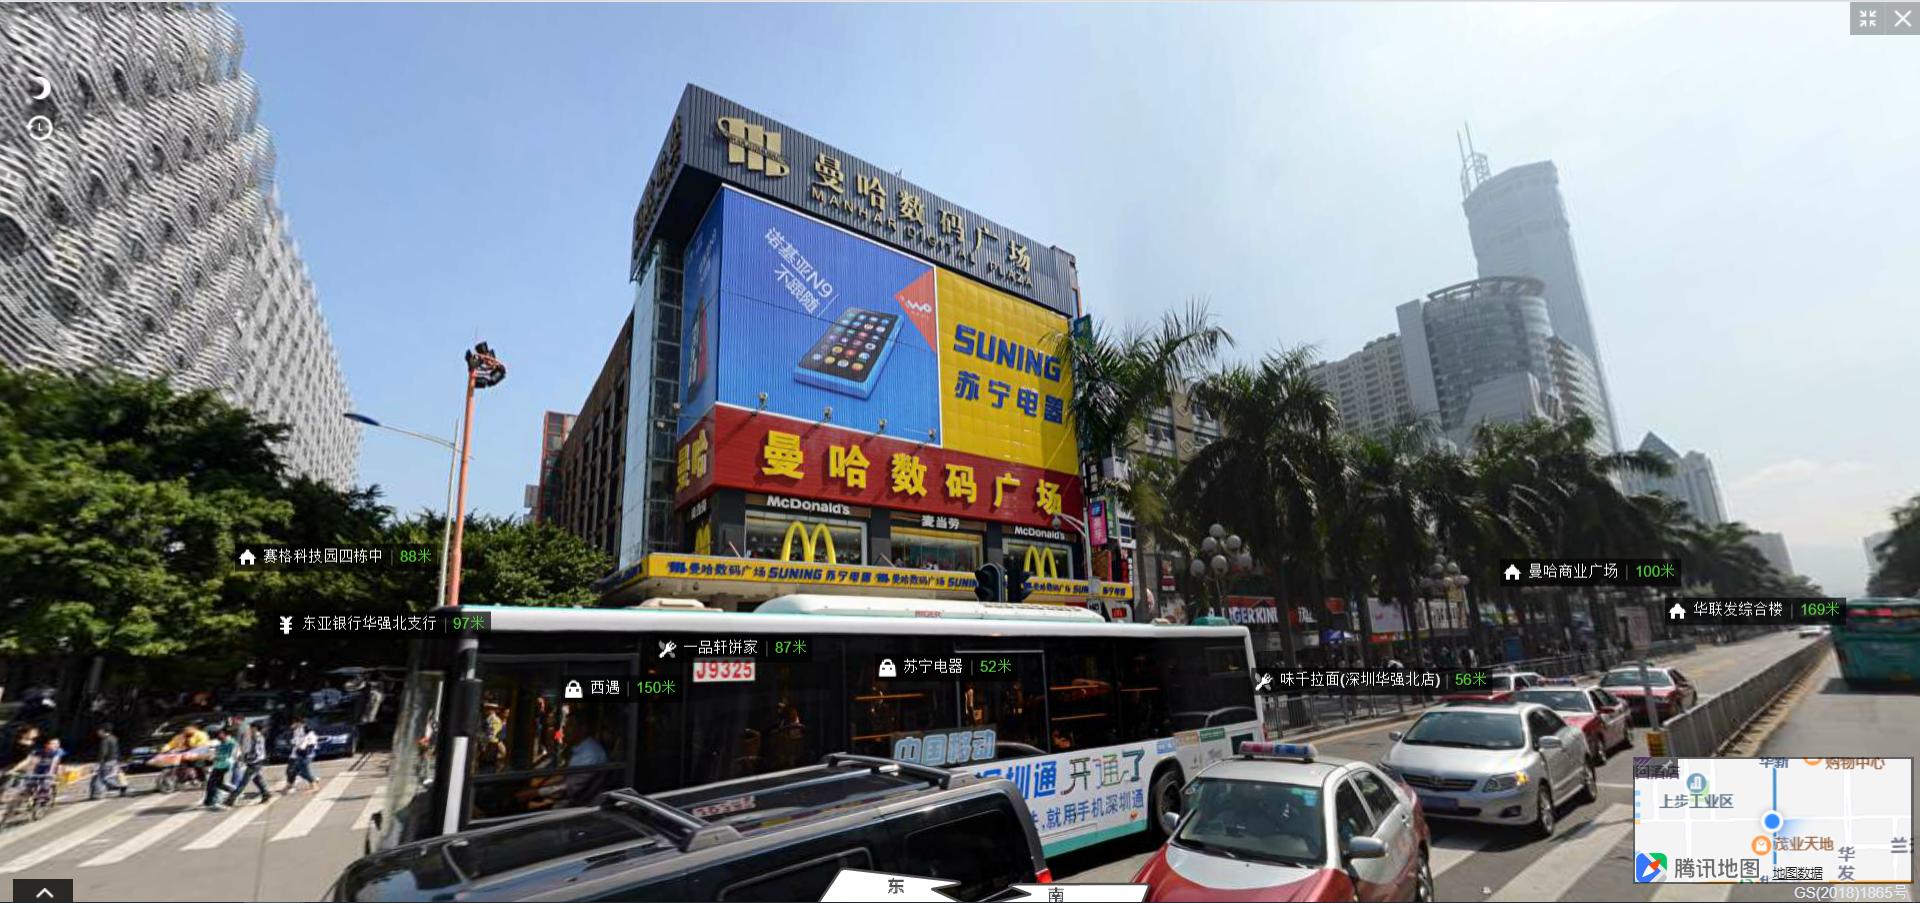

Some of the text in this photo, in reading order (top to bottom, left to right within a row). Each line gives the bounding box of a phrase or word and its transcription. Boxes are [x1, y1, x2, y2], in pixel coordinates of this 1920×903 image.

[811, 186, 1033, 288] MANHAR DIGITAL PLAZA
[814, 152, 1032, 273] 曼哈数码广场
[765, 226, 833, 298] 诺基亚N9
[774, 263, 820, 315] 不跟随
[954, 323, 1062, 383] SUNING
[955, 370, 1064, 425] 苏宁电器
[675, 429, 708, 494] 曼哈
[762, 429, 1062, 515] 曼哈数码广场
[766, 495, 851, 516] McDonald's
[921, 515, 960, 530] 麦当劳
[1014, 526, 1066, 541] McDonald's
[768, 567, 823, 580] SUNING
[947, 576, 978, 589] SUNIN
[695, 660, 753, 679] J9325
[893, 729, 996, 766] 中国移动
